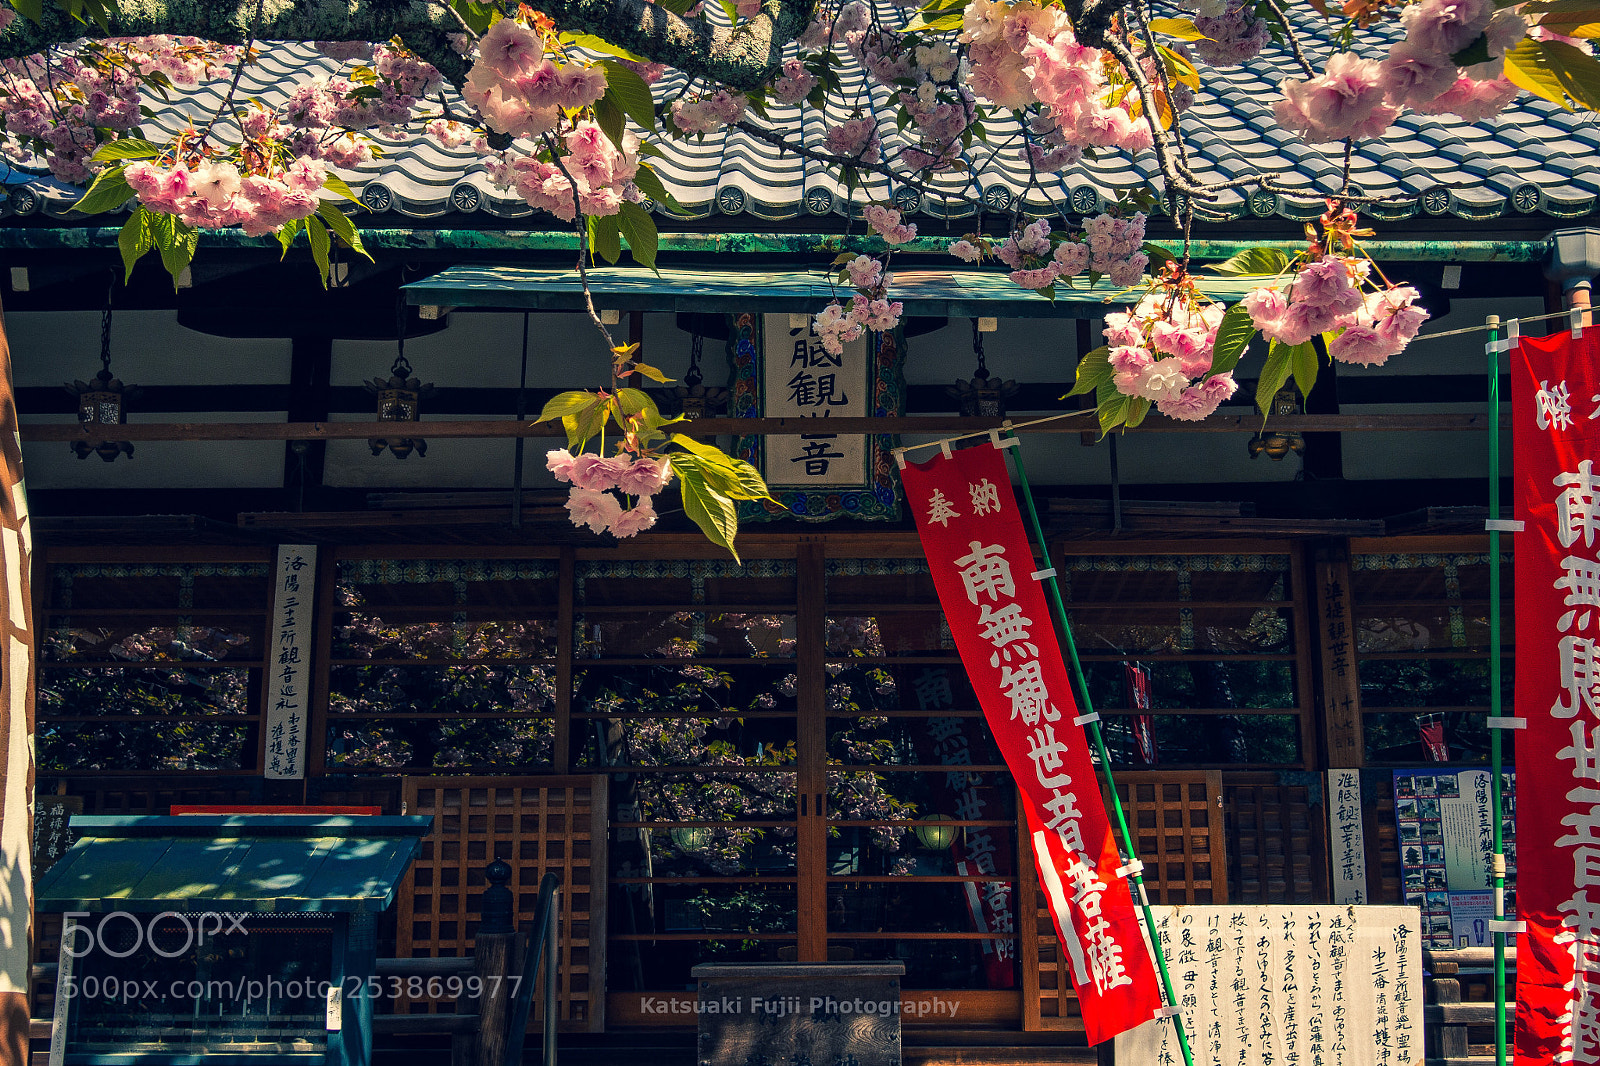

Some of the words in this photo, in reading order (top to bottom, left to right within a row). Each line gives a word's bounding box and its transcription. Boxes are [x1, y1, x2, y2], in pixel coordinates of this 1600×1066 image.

[786, 316, 849, 476] 胝観音
[926, 477, 1003, 528] 奉納
[276, 555, 308, 711] 洛陽三十三所観音巡礼
[954, 540, 1132, 999] 南無観世音菩薩
